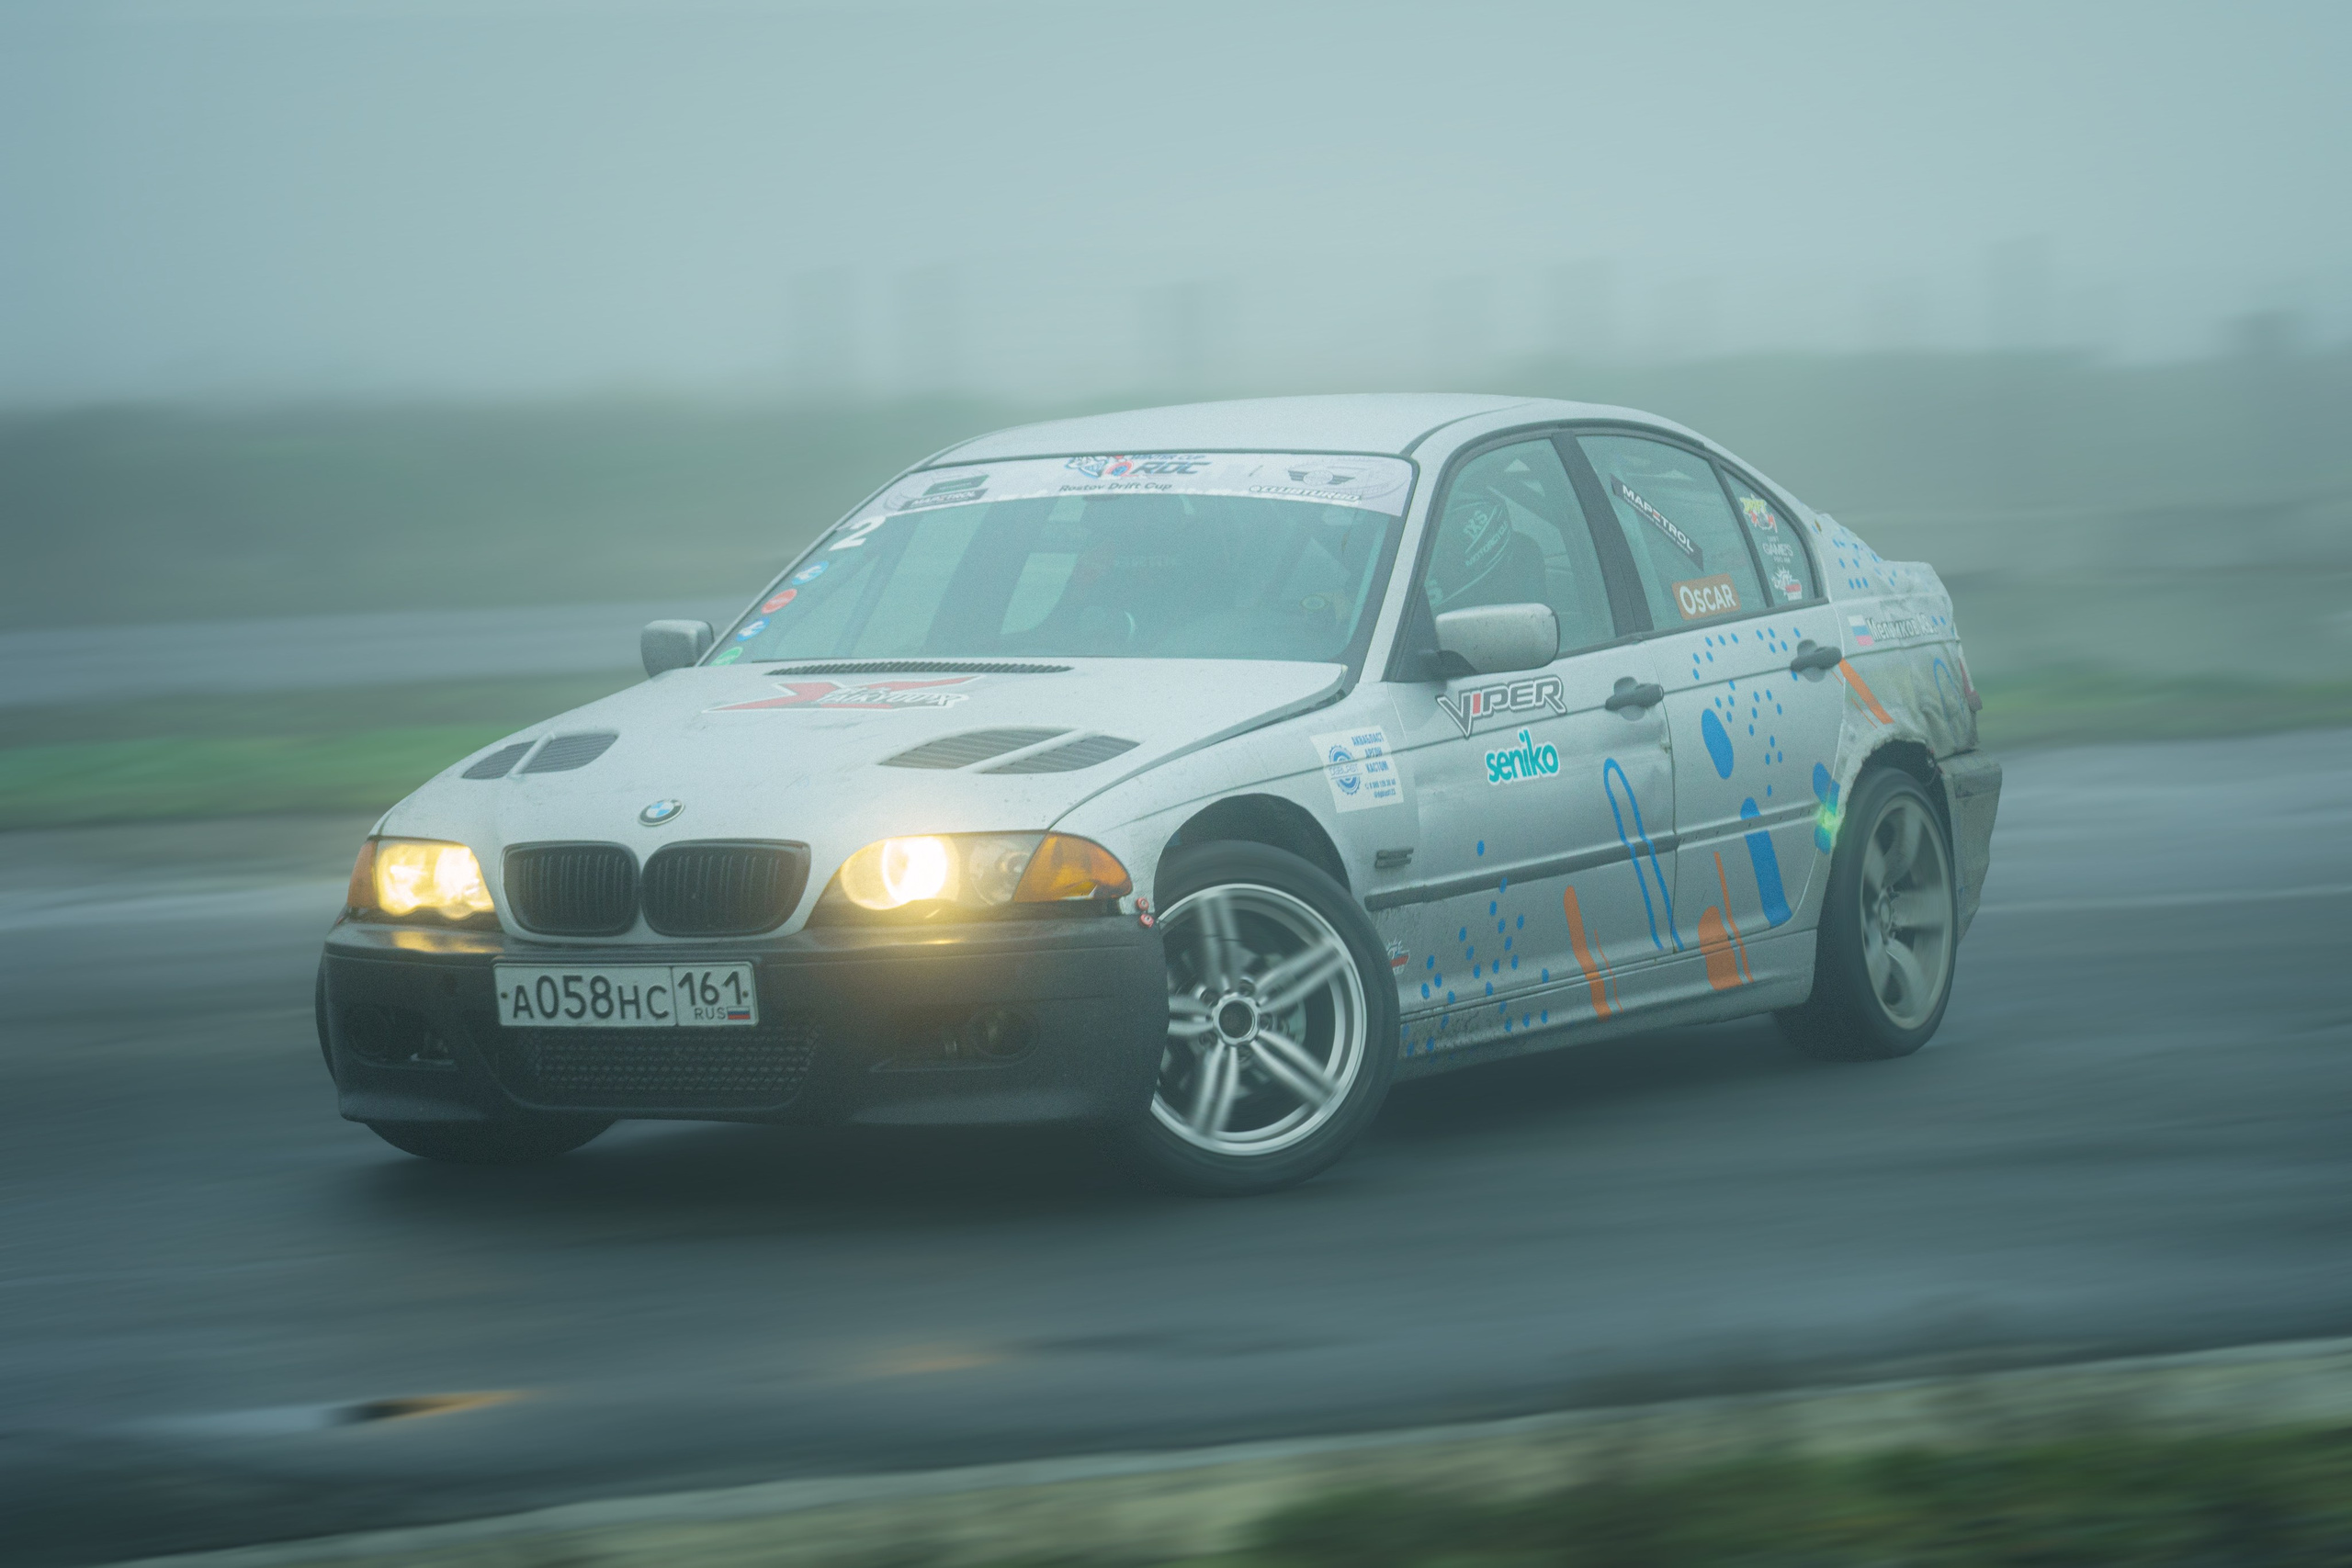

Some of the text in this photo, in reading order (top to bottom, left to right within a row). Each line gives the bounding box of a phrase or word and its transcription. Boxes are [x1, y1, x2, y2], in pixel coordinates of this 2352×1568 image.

[1130, 461, 1213, 475] RDC
[1058, 481, 1173, 493] Rostov Drift Cup
[829, 515, 888, 551] 2
[1622, 483, 1695, 553] MAPETROL
[1762, 543, 1793, 557] GAMES
[1679, 583, 1737, 615] OSCAR
[1436, 675, 1567, 739] VIPER
[1365, 761, 1389, 773] КАСТОМ
[1485, 728, 1560, 783] seniko
[512, 971, 742, 1020] А058НС 161
[694, 1007, 727, 1021] RUS
